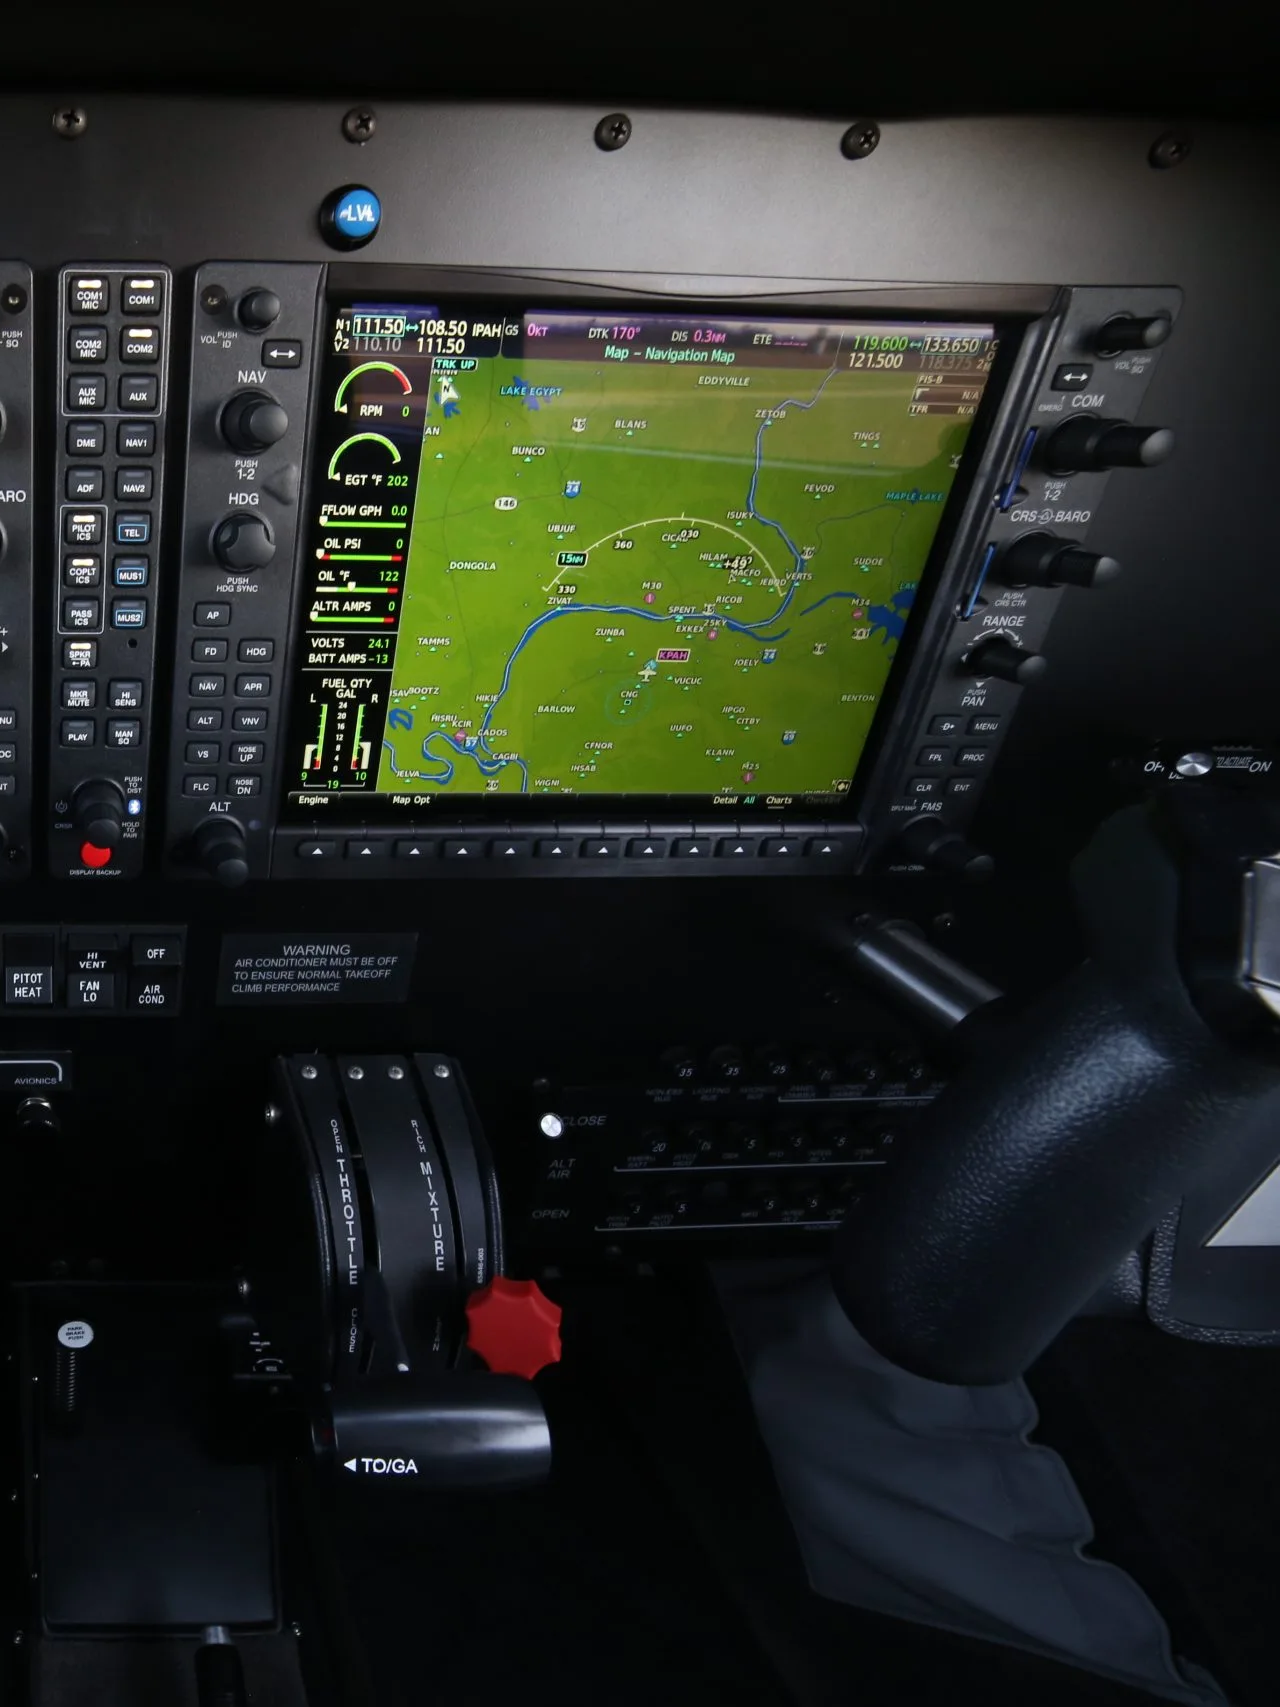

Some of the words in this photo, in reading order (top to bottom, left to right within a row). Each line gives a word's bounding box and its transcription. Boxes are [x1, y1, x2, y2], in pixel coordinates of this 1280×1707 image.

[77, 292, 102, 300] COM1
[129, 296, 154, 304] COM1
[82, 301, 98, 309] MIC
[355, 318, 404, 334] 111.50
[419, 320, 467, 336] 108.50
[472, 324, 502, 337] IPAH
[76, 340, 101, 348] COM2
[127, 345, 152, 353] COM2
[853, 336, 908, 350] 119.600
[925, 337, 979, 353] 133.650
[80, 350, 96, 358] MIC
[605, 346, 629, 361] Map
[645, 347, 708, 362] Navigation
[711, 350, 735, 365] Map
[849, 353, 903, 368] 121.500
[920, 355, 971, 371] 118.375
[238, 370, 267, 383] NAV
[698, 376, 749, 386] EDDYVILLE
[79, 388, 96, 396] AUX
[130, 392, 147, 400] AUX
[79, 397, 95, 405] MIC
[1072, 394, 1105, 408] COM
[77, 439, 95, 447] DME
[126, 439, 147, 447] NAV1
[229, 493, 259, 504] HDG
[1044, 490, 1061, 500] 1-2
[321, 505, 356, 515] FFLOW
[359, 506, 382, 516] GPH
[391, 506, 407, 516] 0.0
[1010, 510, 1036, 521] CRS
[1055, 511, 1091, 522] BARO
[72, 524, 96, 532] PILOT
[125, 529, 140, 537] TEL
[450, 562, 496, 570] DONGOLA
[120, 572, 142, 580] MUS1
[72, 610, 92, 618] PASS
[118, 614, 140, 622] MUS2
[982, 616, 1026, 626] RANGE
[312, 638, 344, 648] VOLTS
[368, 639, 389, 648] 24.1
[322, 679, 346, 688] FUEL
[350, 679, 372, 689] QTY
[336, 689, 356, 698] GAL
[1249, 762, 1272, 772] ON
[147, 949, 166, 959] OFF
[283, 945, 351, 956] WARNING
[87, 952, 98, 960] HI
[79, 961, 106, 969] VENT
[235, 958, 252, 967] AIR
[255, 958, 327, 967] CONDITIONER
[330, 957, 358, 966] MUST
[361, 957, 375, 966] BE
[378, 956, 398, 966] OFF
[13, 973, 42, 984] PITOT
[234, 972, 248, 980] TO
[251, 971, 294, 980] ENSURE
[298, 970, 341, 979] NORMAL
[345, 970, 391, 979] TAKEOFF
[79, 981, 99, 991] FAN
[144, 985, 160, 994] AIR
[232, 984, 262, 993] CLIMB
[265, 983, 340, 993] PERFORMANCE
[15, 987, 42, 997] HEAT
[84, 993, 97, 1002] LO
[139, 995, 164, 1004] COND
[561, 1115, 607, 1127] CLOSE
[330, 1119, 343, 1153] OPEN
[411, 1120, 427, 1152] RICH
[549, 1158, 576, 1169] ALT
[547, 1168, 570, 1180] AIR
[420, 1161, 444, 1271] MIXTURE
[532, 1209, 570, 1220] OPEN
[337, 1159, 357, 1284] THROTTLE
[362, 1458, 418, 1473] TO/GA
